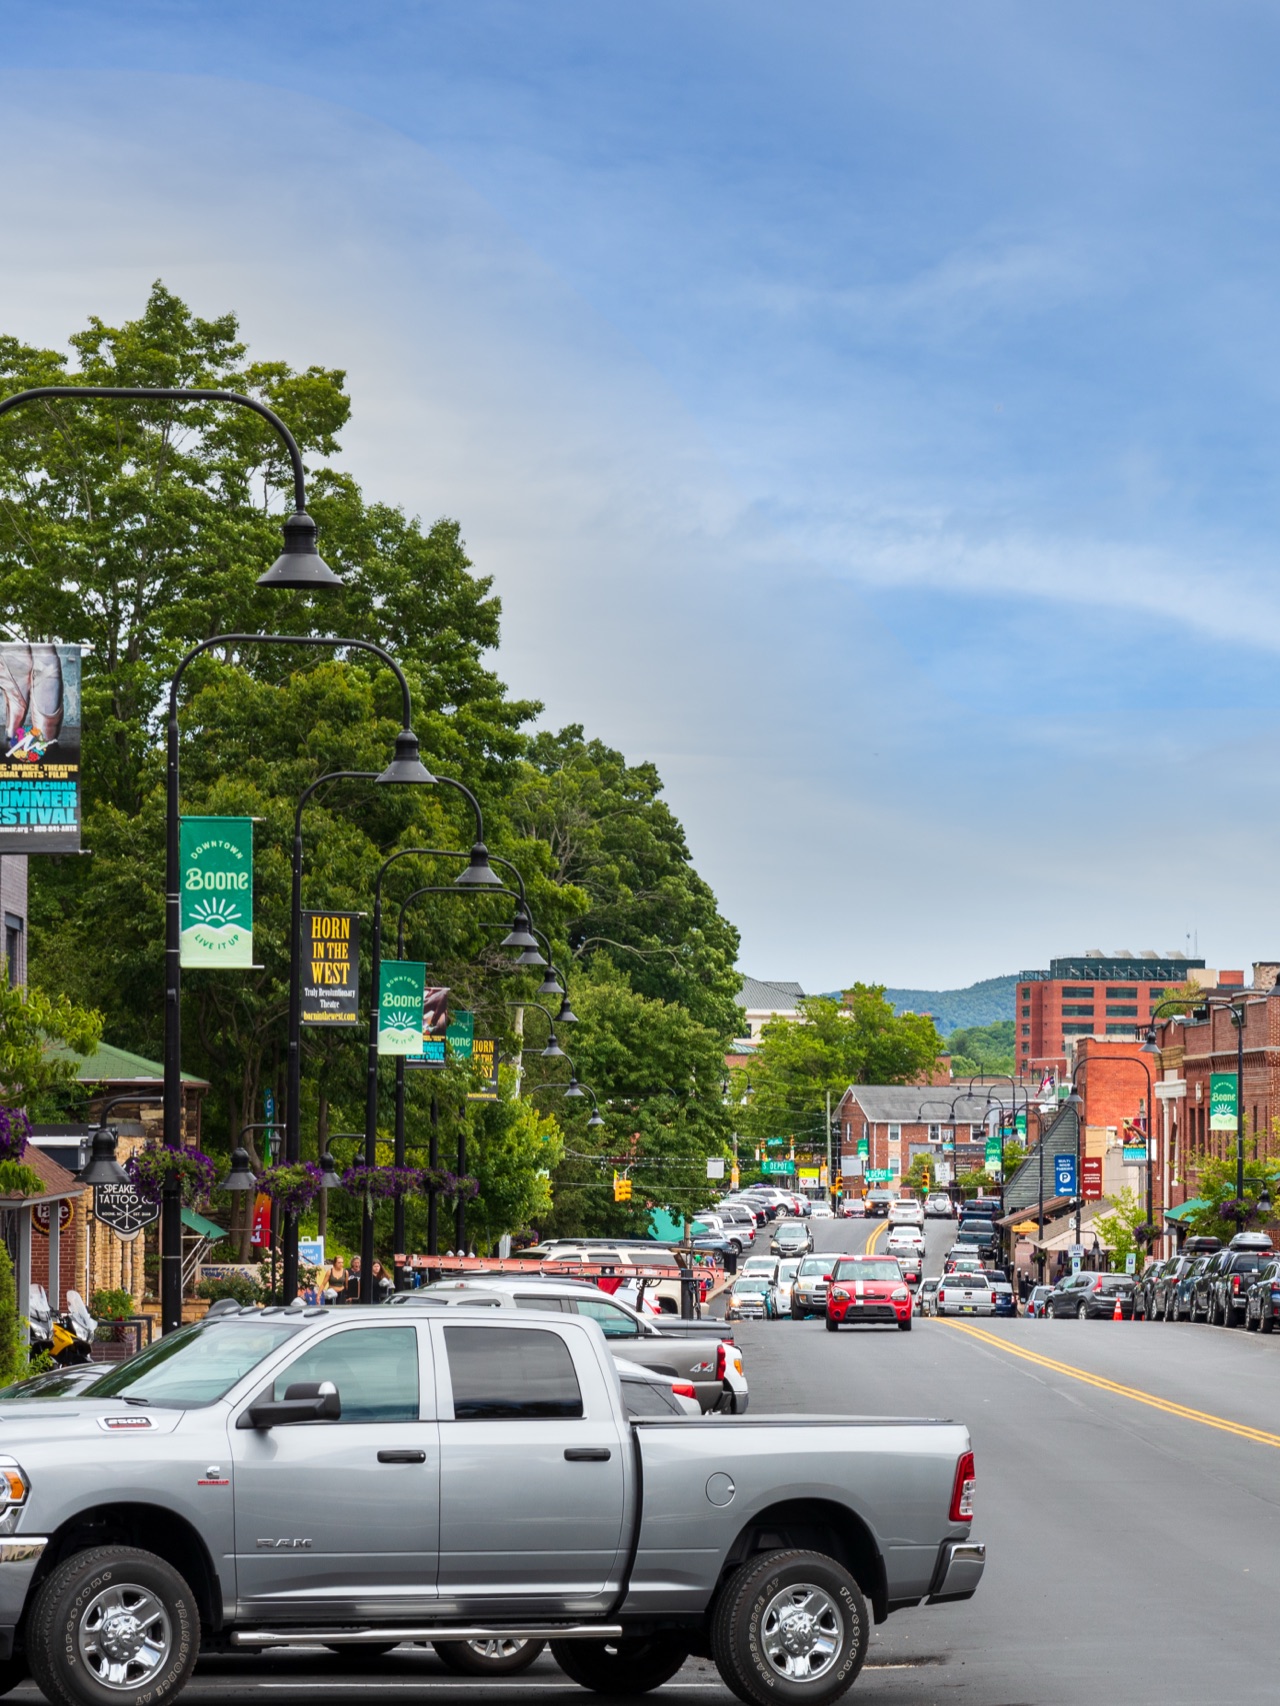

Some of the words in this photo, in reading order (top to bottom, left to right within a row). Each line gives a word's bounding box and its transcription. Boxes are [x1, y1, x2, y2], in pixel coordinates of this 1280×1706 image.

[11, 764, 40, 772] DANCE
[43, 764, 78, 772] THEATRE
[0, 782, 76, 790] APPALACHIAN
[0, 808, 77, 825] STIVAL
[190, 840, 243, 860] DOWNTOWN
[185, 867, 249, 890] Boone
[311, 916, 350, 939] HORN
[194, 934, 214, 950] LIVE
[218, 942, 227, 950] IT
[228, 934, 239, 946] UP
[313, 942, 324, 959] IN
[327, 942, 349, 959] THE
[311, 962, 350, 985] WEST
[386, 976, 418, 988] DOWNTOWN
[304, 987, 318, 998] Truly
[382, 992, 422, 1008] Boone
[447, 1036, 471, 1047] oone
[770, 1162, 787, 1170] DEPOT
[103, 1184, 136, 1194] SPEAKE
[99, 1194, 139, 1204] TATTOO
[108, 1417, 147, 1425] 2500
[256, 1538, 313, 1548] RAM
[749, 1596, 775, 1687] TRANSFORCE
[766, 1577, 779, 1595] AT
[156, 1599, 190, 1697] TRANSFORCE
[136, 1691, 152, 1706] AT
